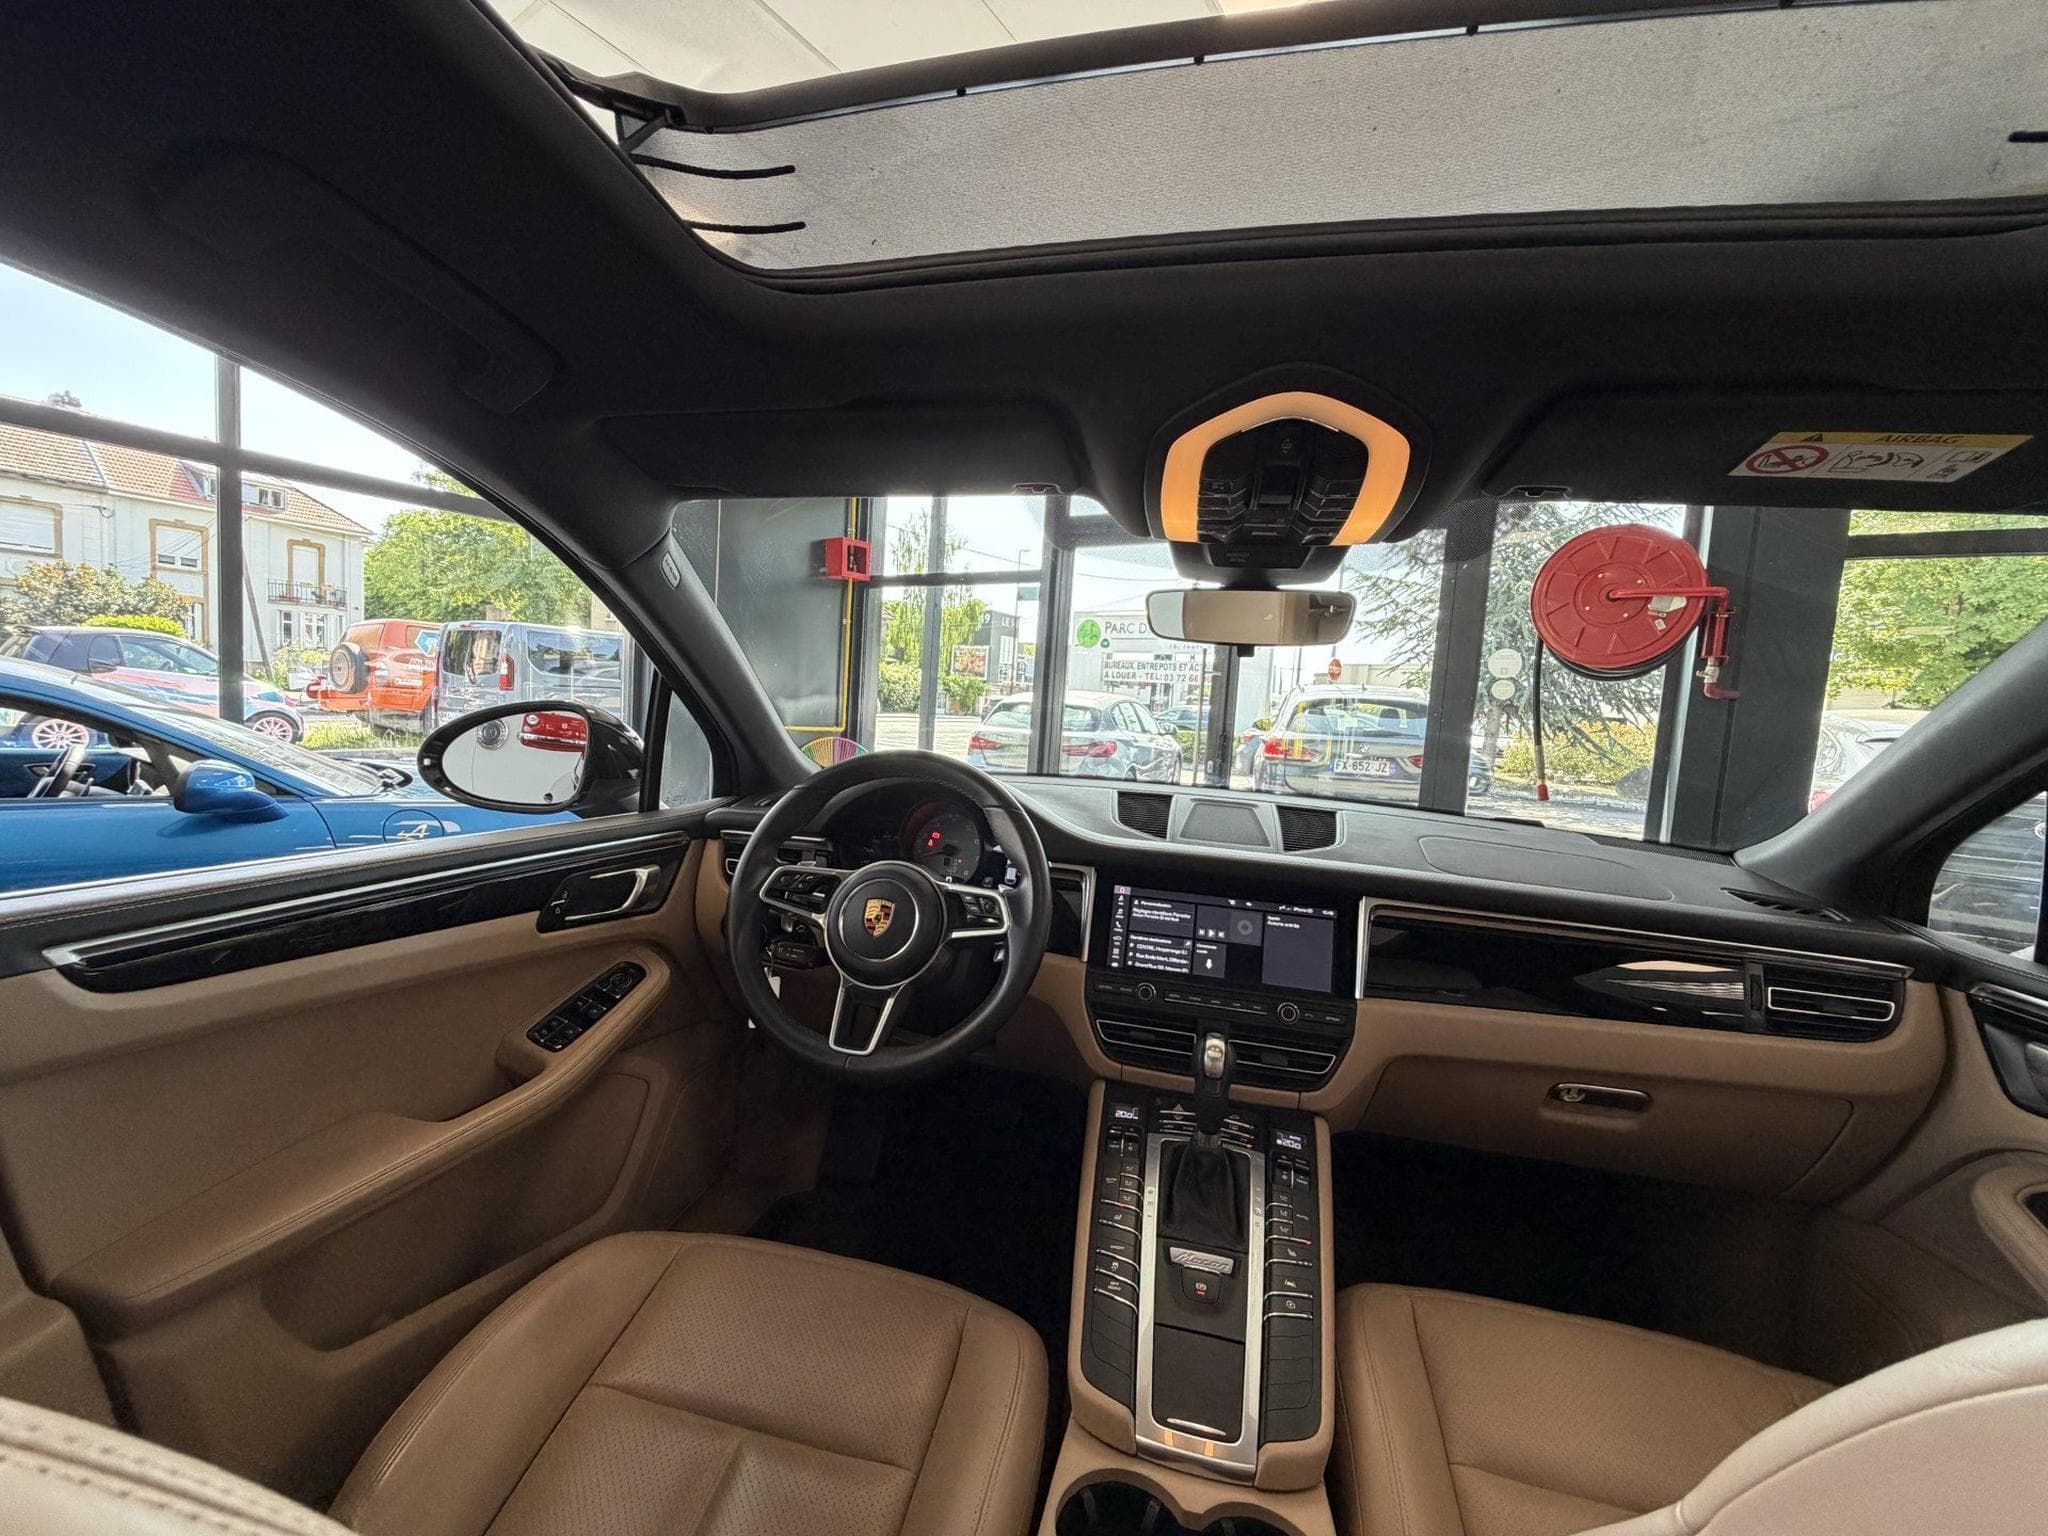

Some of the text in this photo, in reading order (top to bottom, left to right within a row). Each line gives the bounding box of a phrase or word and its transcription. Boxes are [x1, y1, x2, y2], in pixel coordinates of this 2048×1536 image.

[1875, 434, 1964, 444] AIRBAG
[1104, 621, 1136, 634] PARC
[1137, 661, 1177, 671] ENTREPOTS
[1178, 662, 1188, 672] ET
[1111, 671, 1137, 680] LOUER
[1164, 674, 1174, 682] 03
[1176, 674, 1187, 682] 72
[1174, 1251, 1231, 1269] Macan
